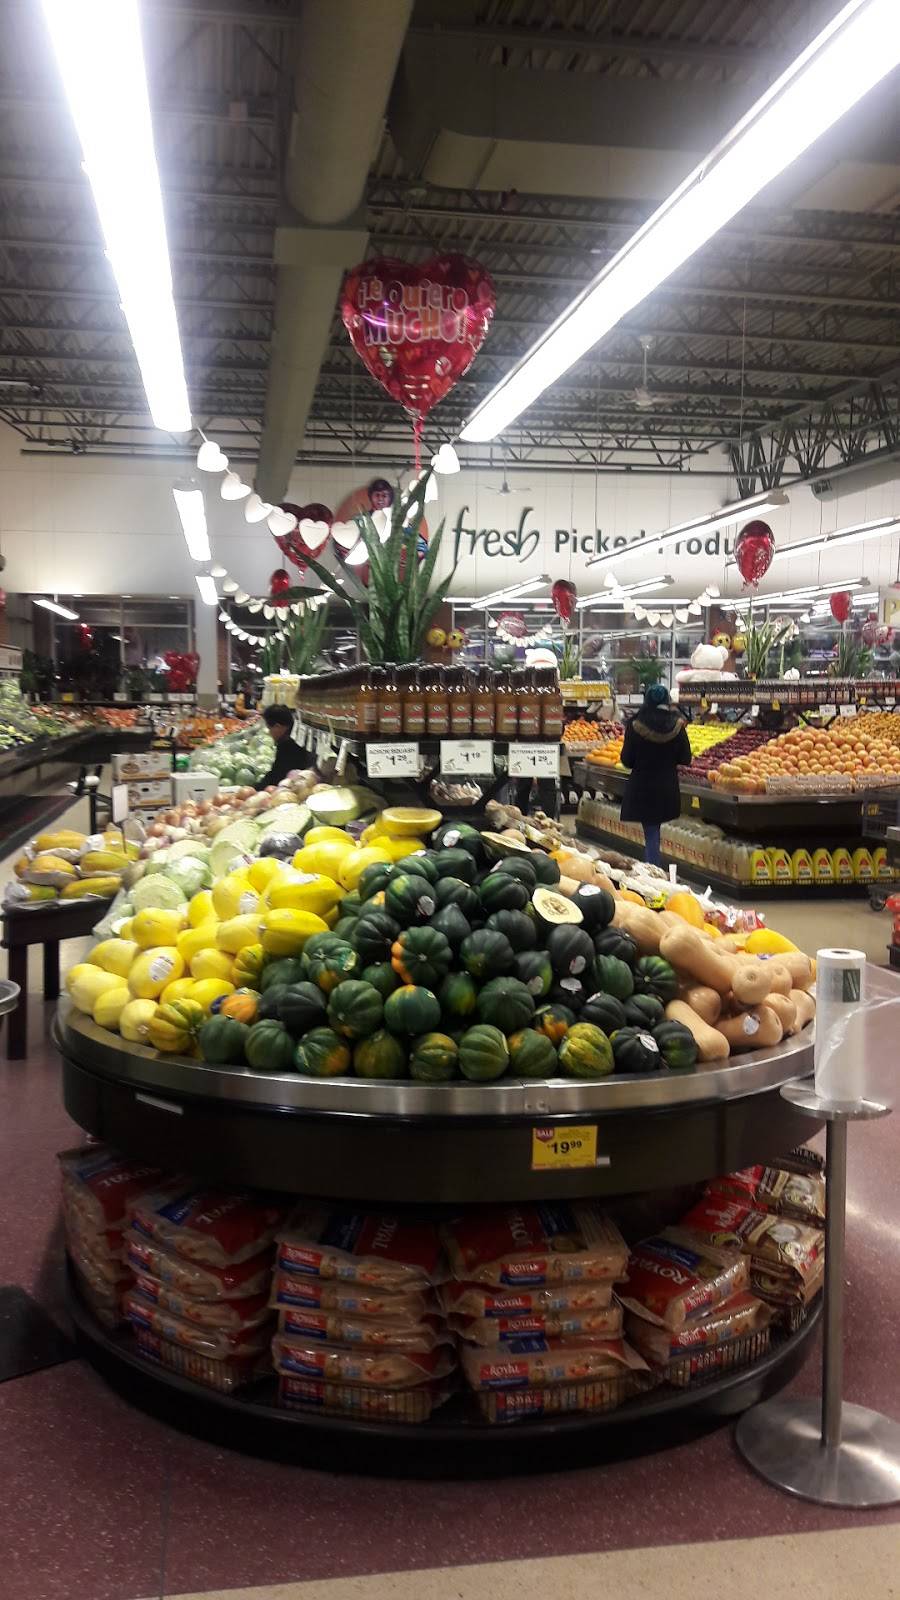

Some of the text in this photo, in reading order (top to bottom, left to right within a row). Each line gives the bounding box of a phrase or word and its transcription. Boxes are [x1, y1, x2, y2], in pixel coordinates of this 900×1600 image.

[452, 506, 540, 567] fresh
[493, 1298, 524, 1308] ROYAL
[508, 1318, 540, 1329] ROYAL
[488, 1363, 520, 1377] ROYAL
